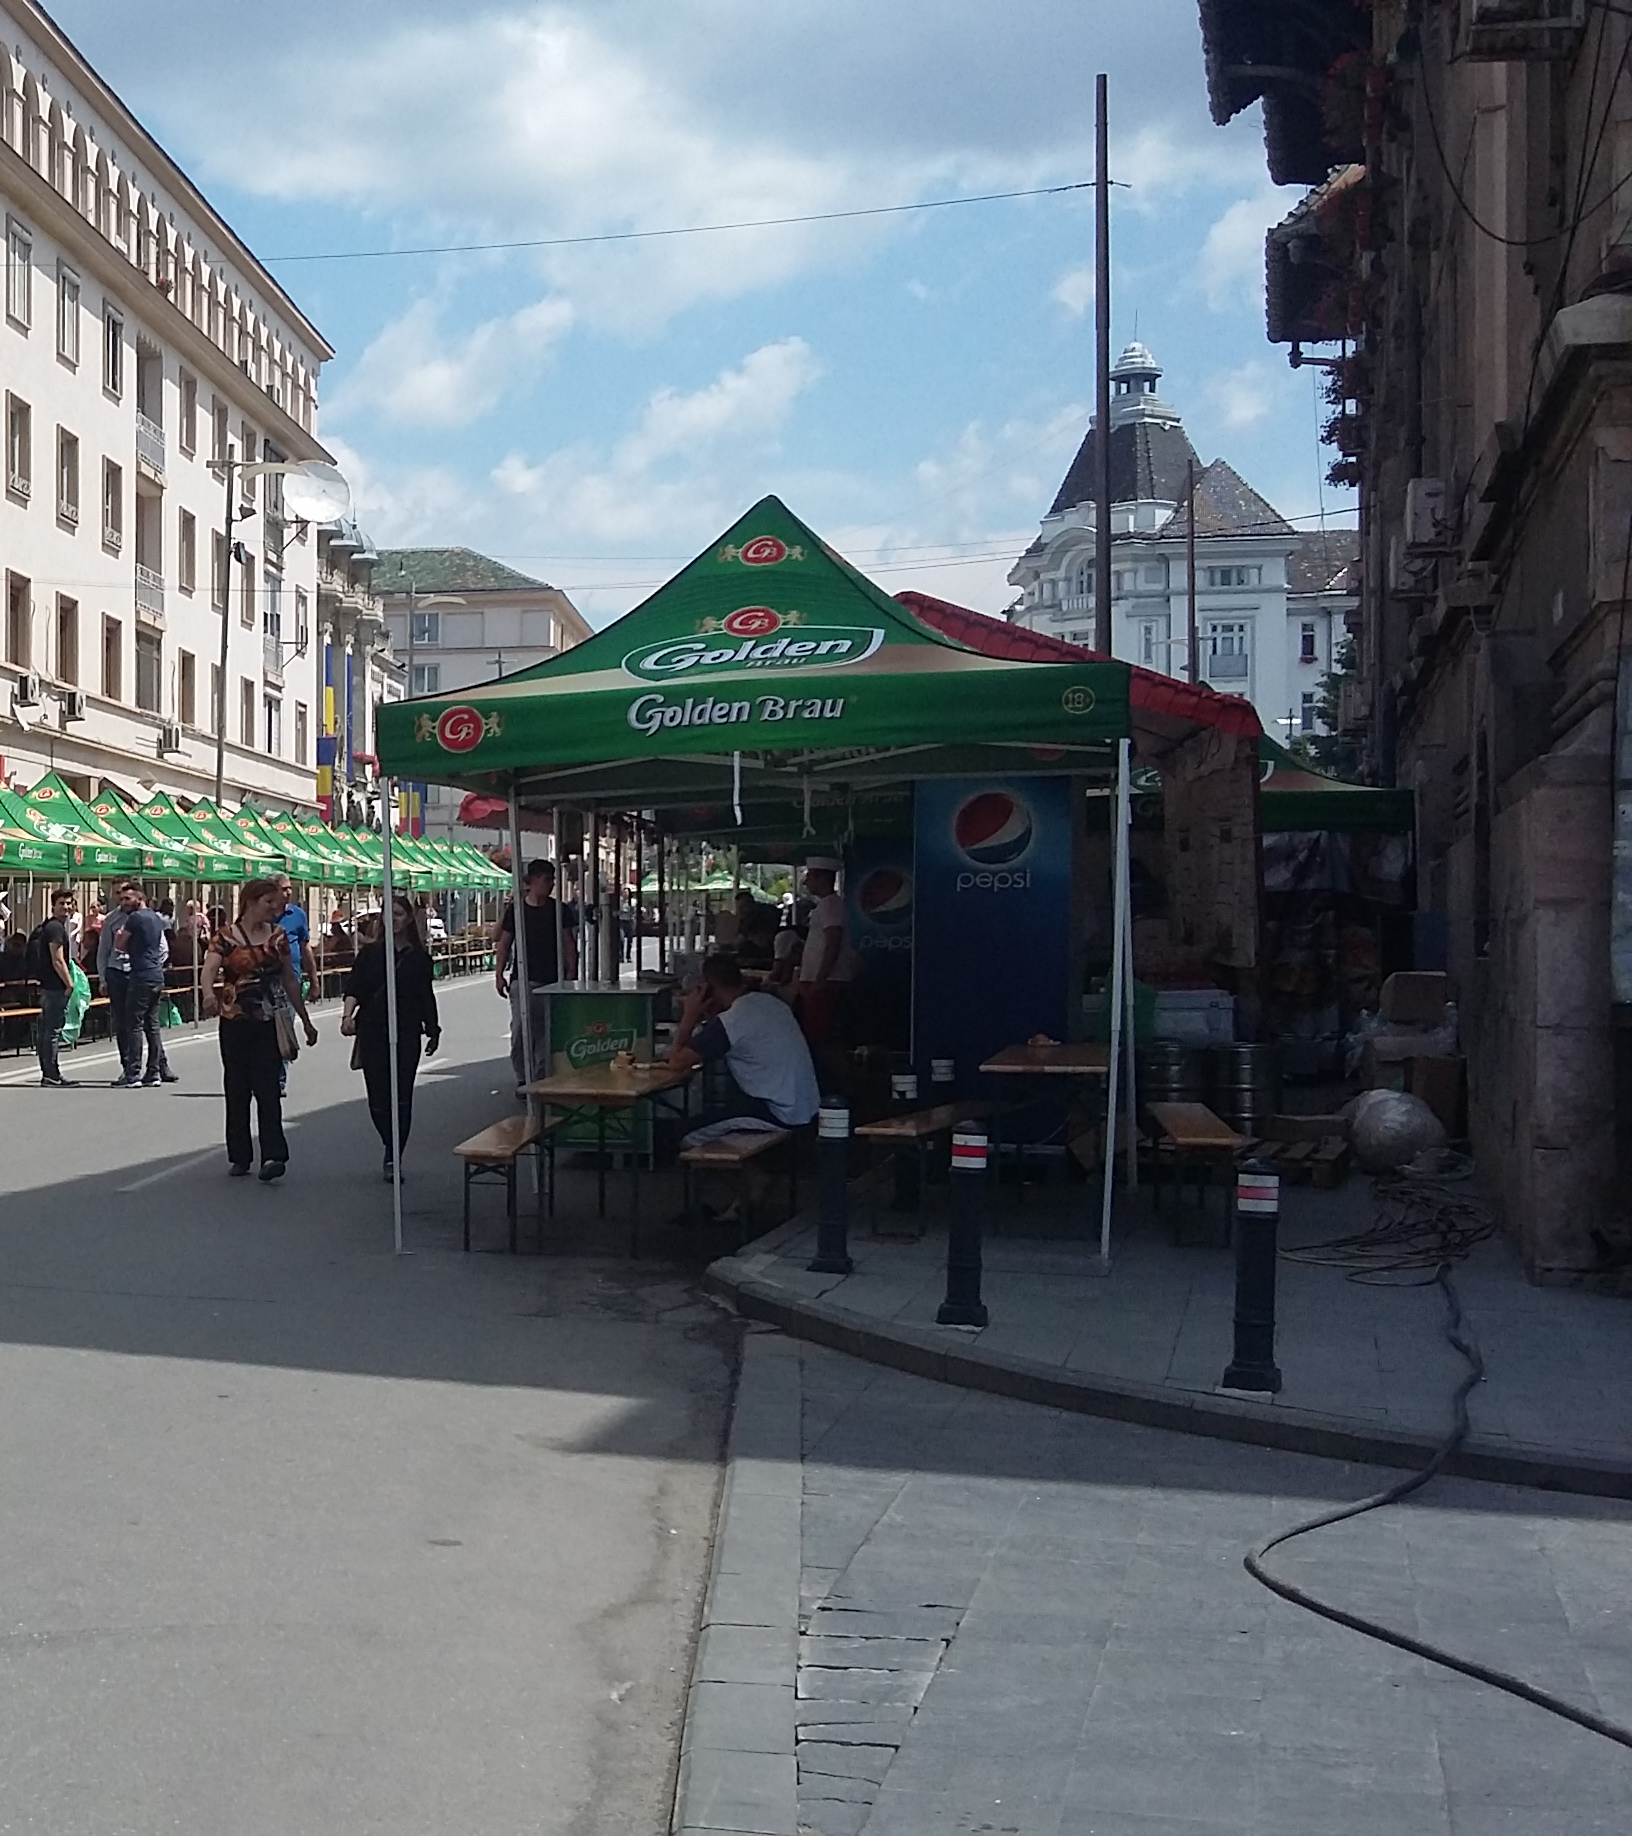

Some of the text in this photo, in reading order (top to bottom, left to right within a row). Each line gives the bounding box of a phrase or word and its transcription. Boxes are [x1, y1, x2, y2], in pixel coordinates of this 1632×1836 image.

[638, 637, 853, 673] Golden
[627, 693, 844, 737] Golden Brau
[956, 869, 1032, 892] pepsi
[859, 934, 914, 951] peps
[569, 1035, 629, 1060] Golden
